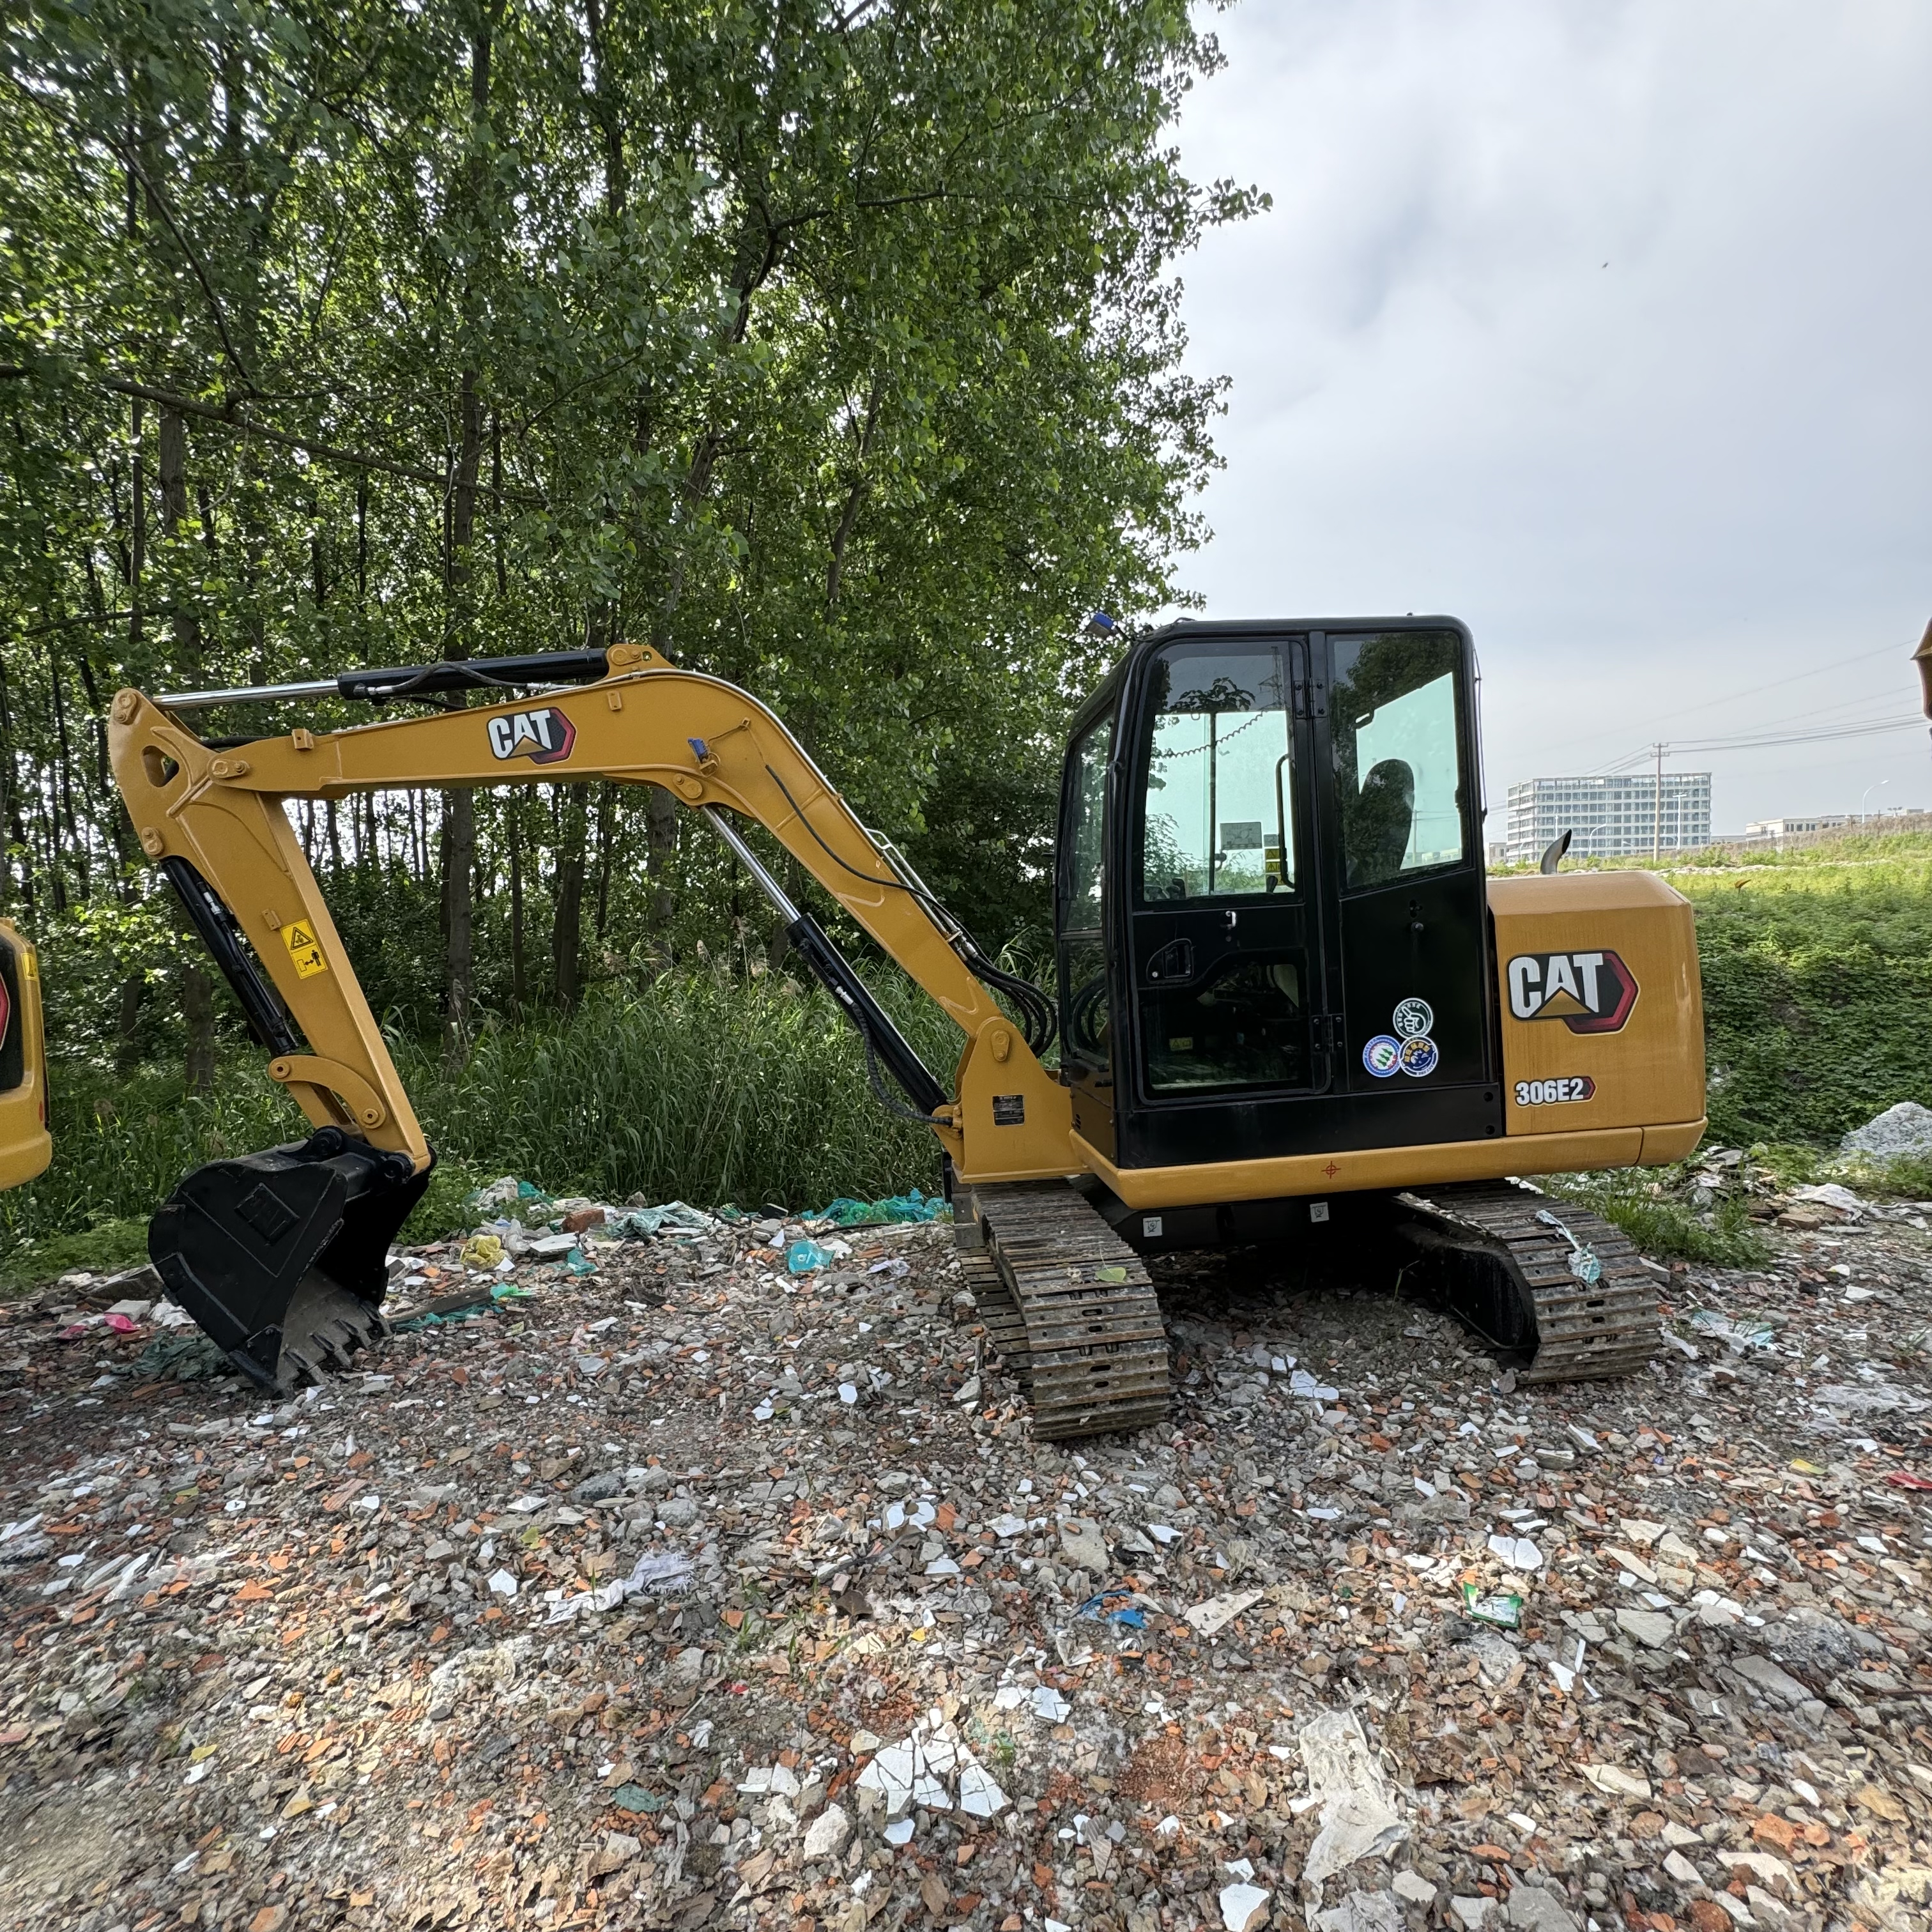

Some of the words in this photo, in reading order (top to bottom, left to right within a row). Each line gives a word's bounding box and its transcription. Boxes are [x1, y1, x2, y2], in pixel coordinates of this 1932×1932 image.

[488, 709, 552, 758] CAT
[1508, 953, 1604, 1018] CAT
[1515, 1078, 1584, 1105] 306E2
